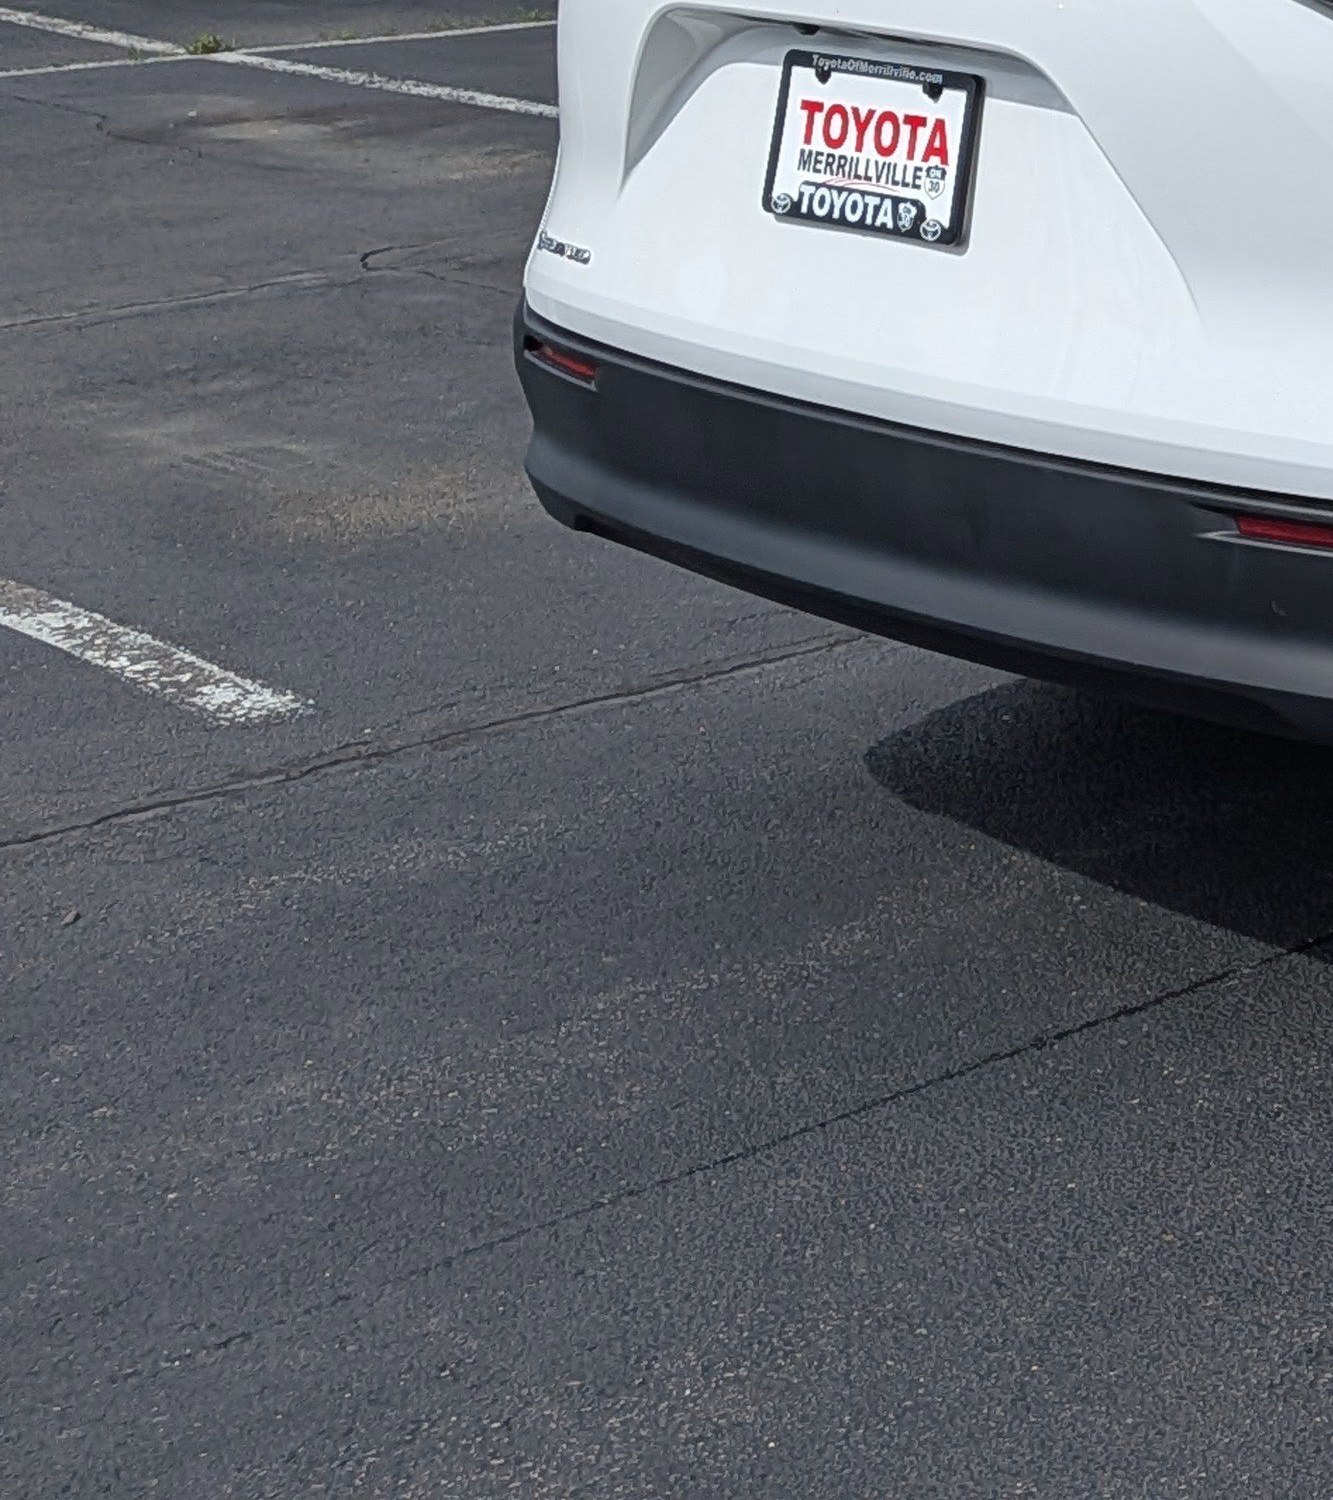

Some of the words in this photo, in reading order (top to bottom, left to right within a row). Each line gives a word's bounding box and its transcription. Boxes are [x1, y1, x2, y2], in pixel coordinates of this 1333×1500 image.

[800, 100, 949, 166] TOYOTA
[797, 148, 923, 191] MERRILLVILLE
[799, 184, 894, 230] TOYOTA
